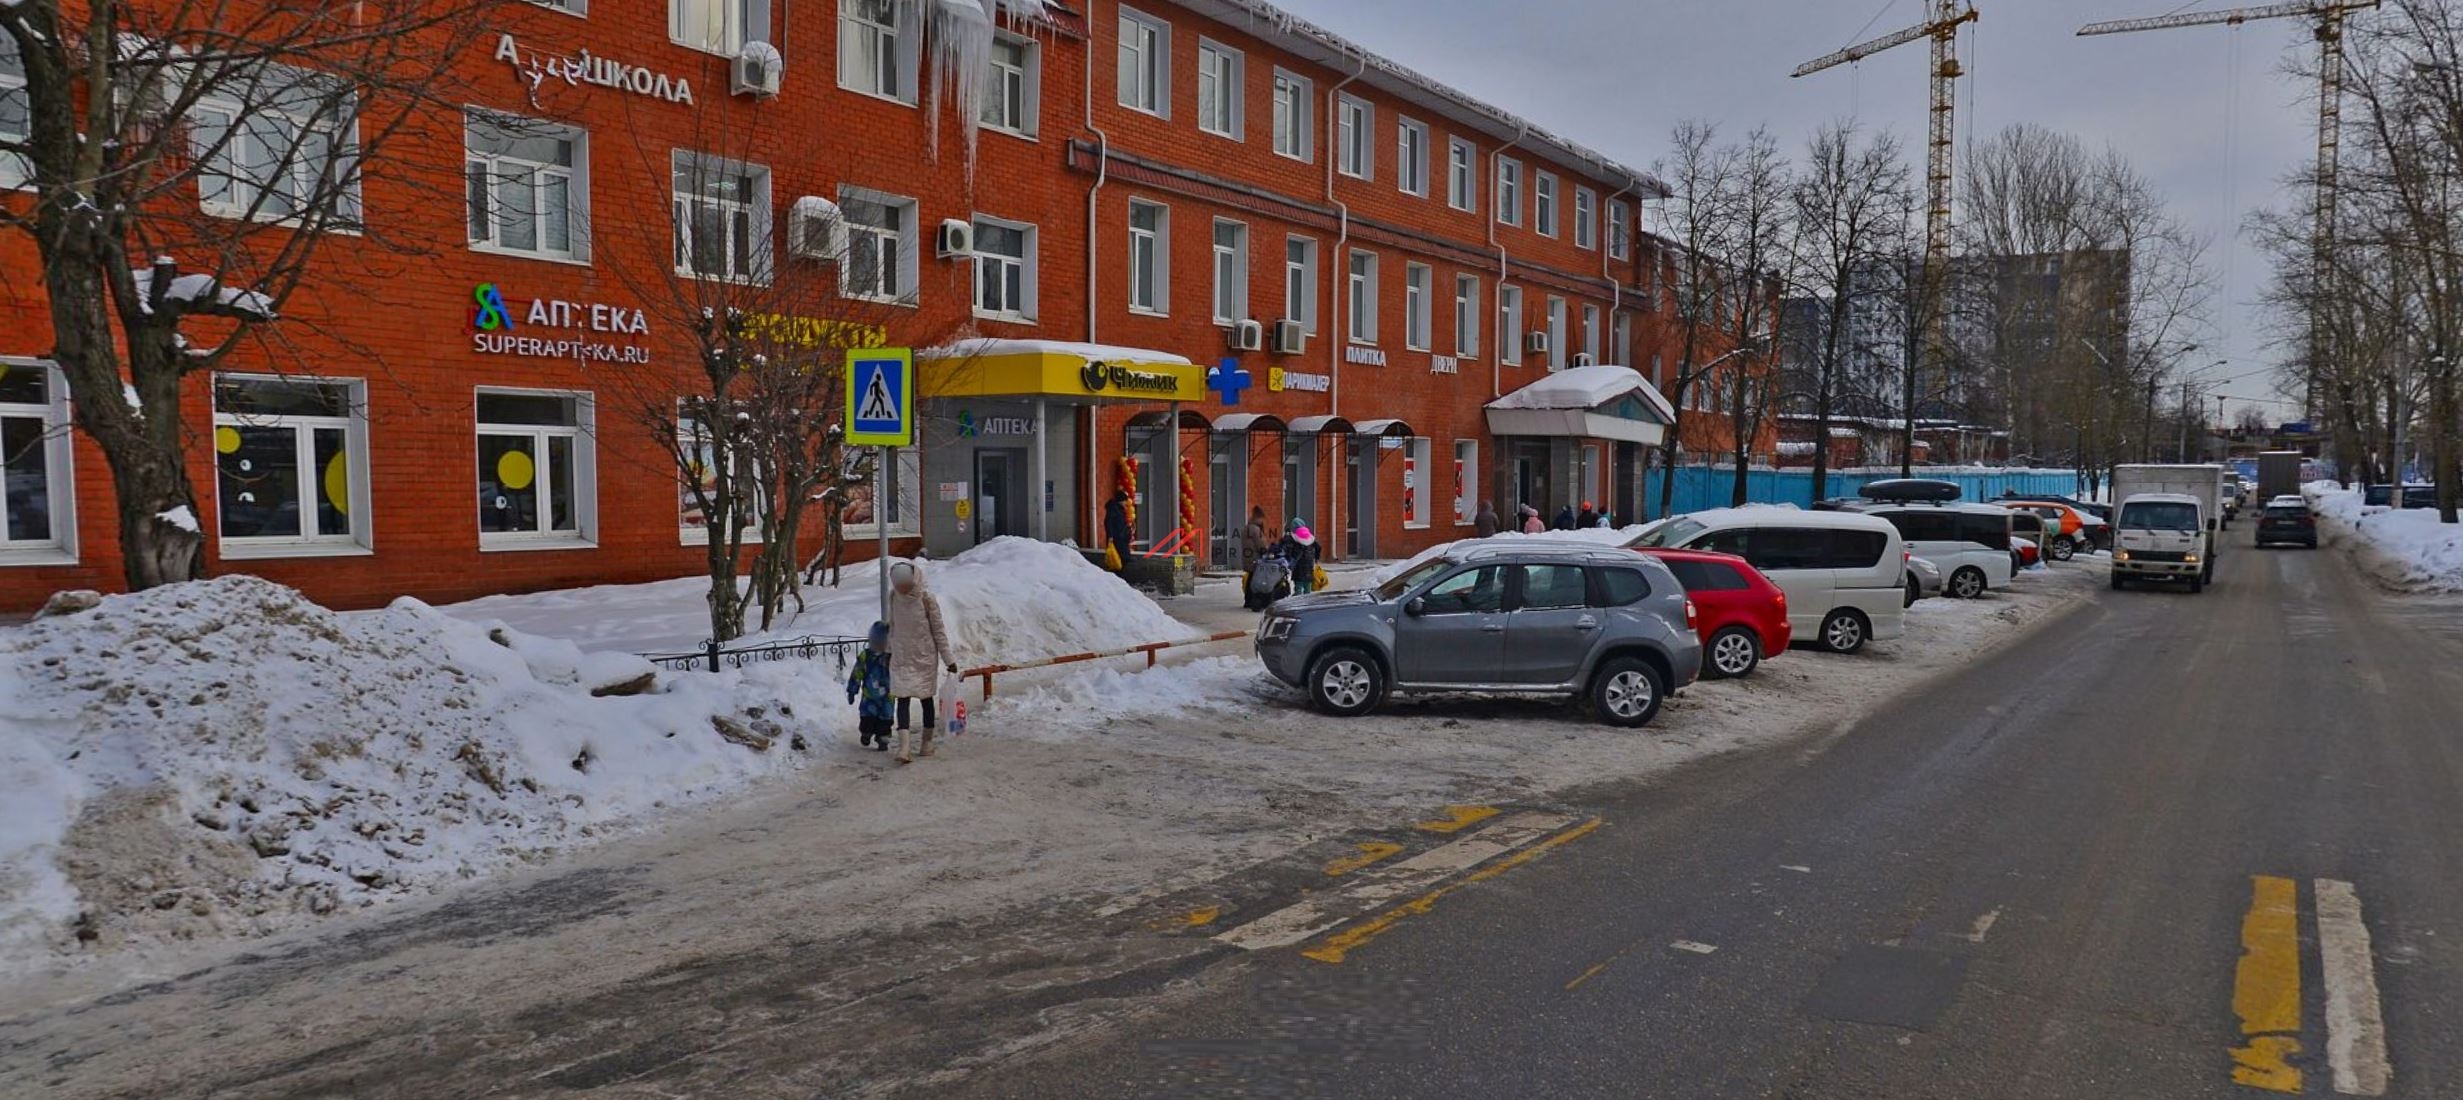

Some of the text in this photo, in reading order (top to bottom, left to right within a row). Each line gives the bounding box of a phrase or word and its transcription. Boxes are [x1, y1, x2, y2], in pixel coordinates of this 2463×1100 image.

[494, 33, 694, 105] АШКОЛА
[527, 297, 650, 336] АПЕКА
[1345, 345, 1387, 368] ПЛИТКА
[1429, 354, 1457, 376] ДВЕРИ
